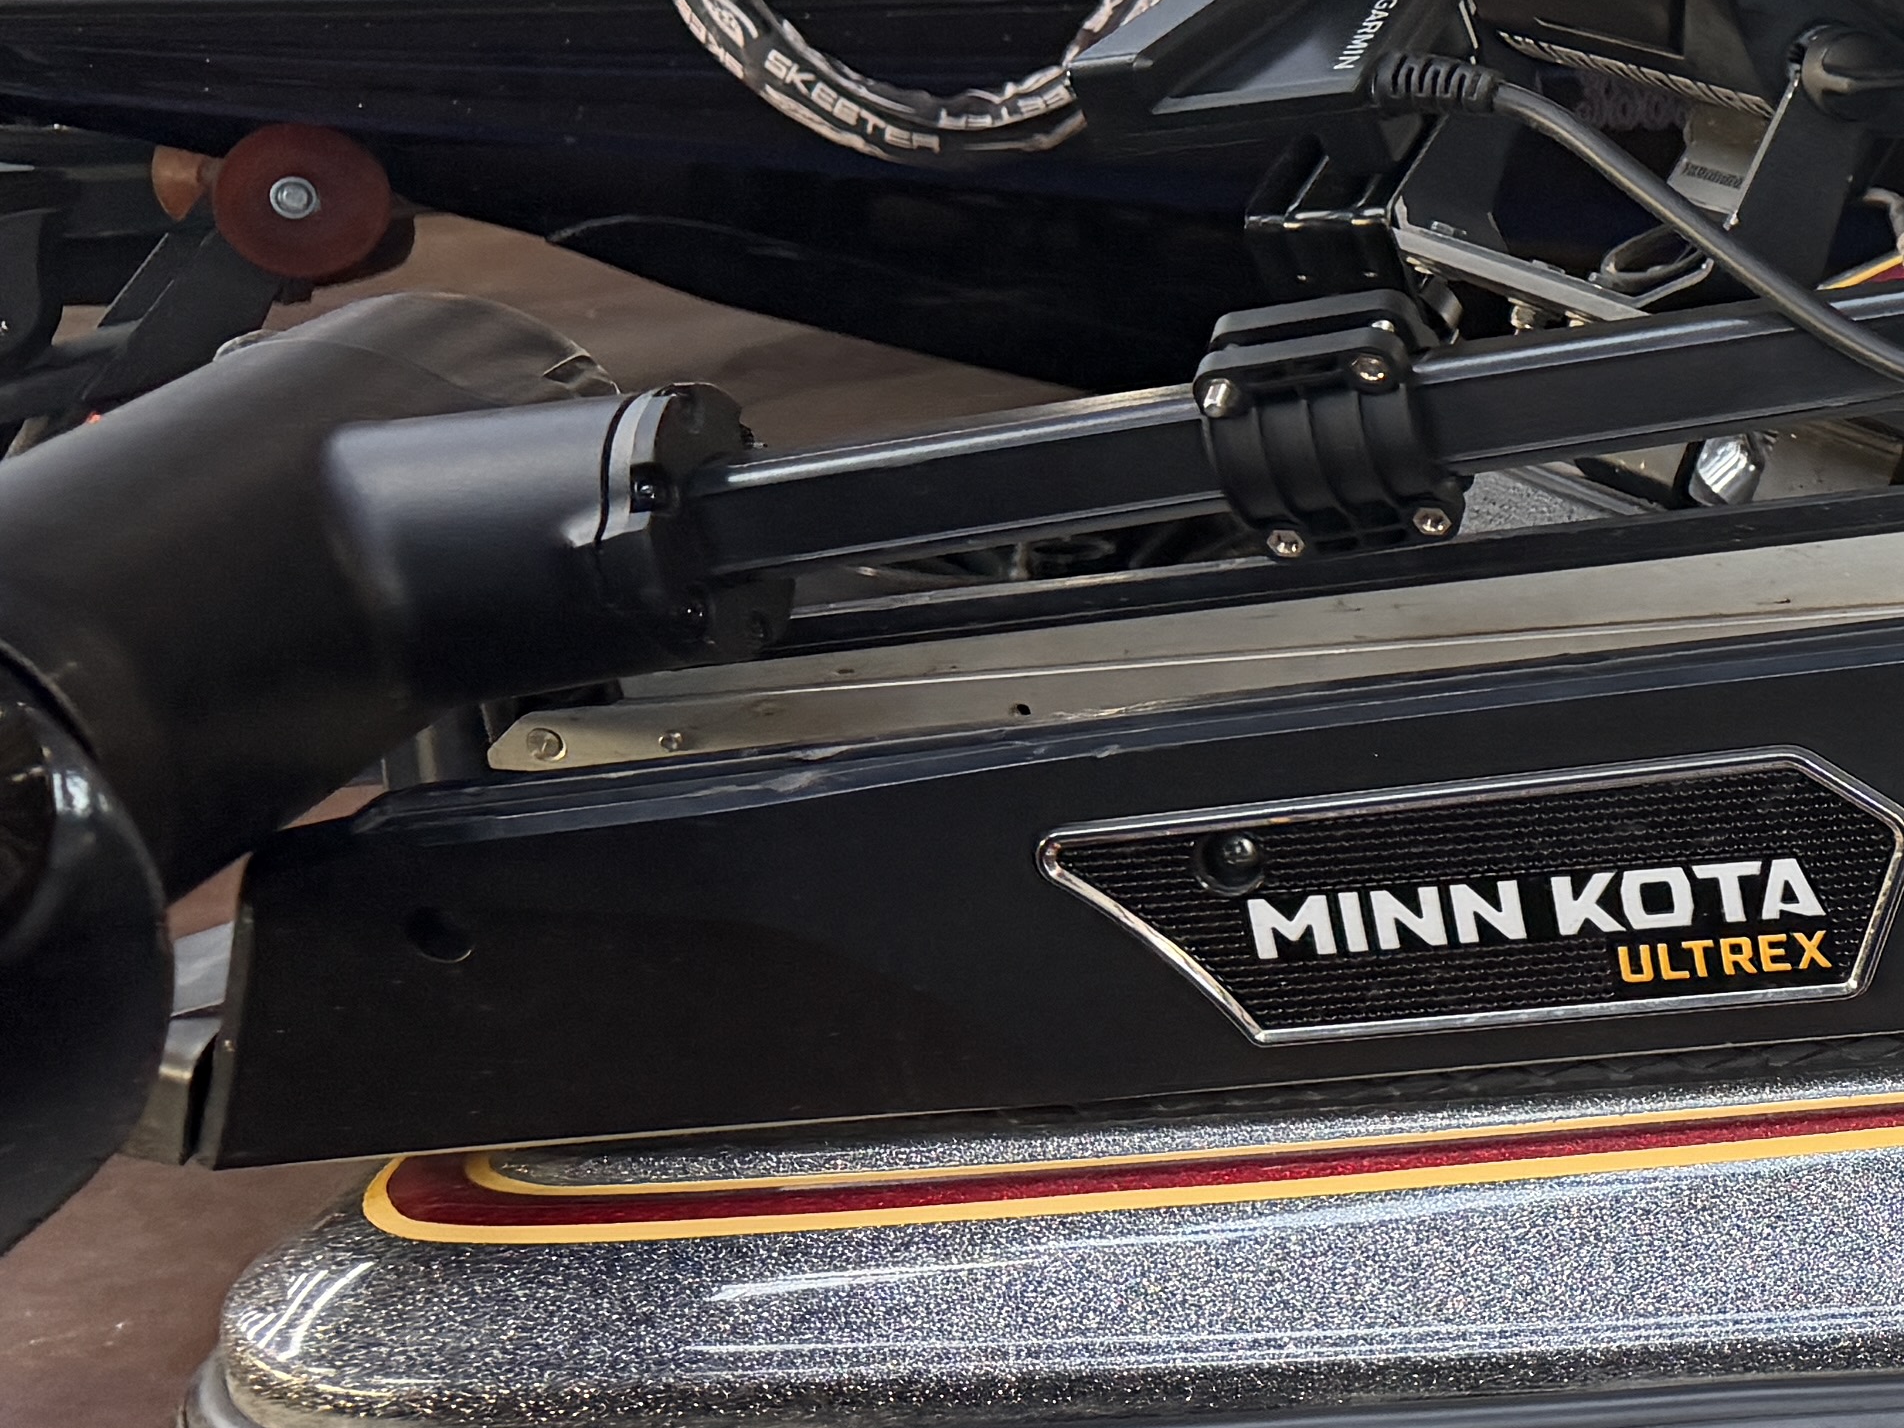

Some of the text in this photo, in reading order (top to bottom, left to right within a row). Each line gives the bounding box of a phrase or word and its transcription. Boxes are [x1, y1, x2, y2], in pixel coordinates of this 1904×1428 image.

[763, 48, 941, 154] SKEETER
[1245, 857, 1827, 961] MINN KOTA
[1616, 929, 1832, 984] ULTREX
